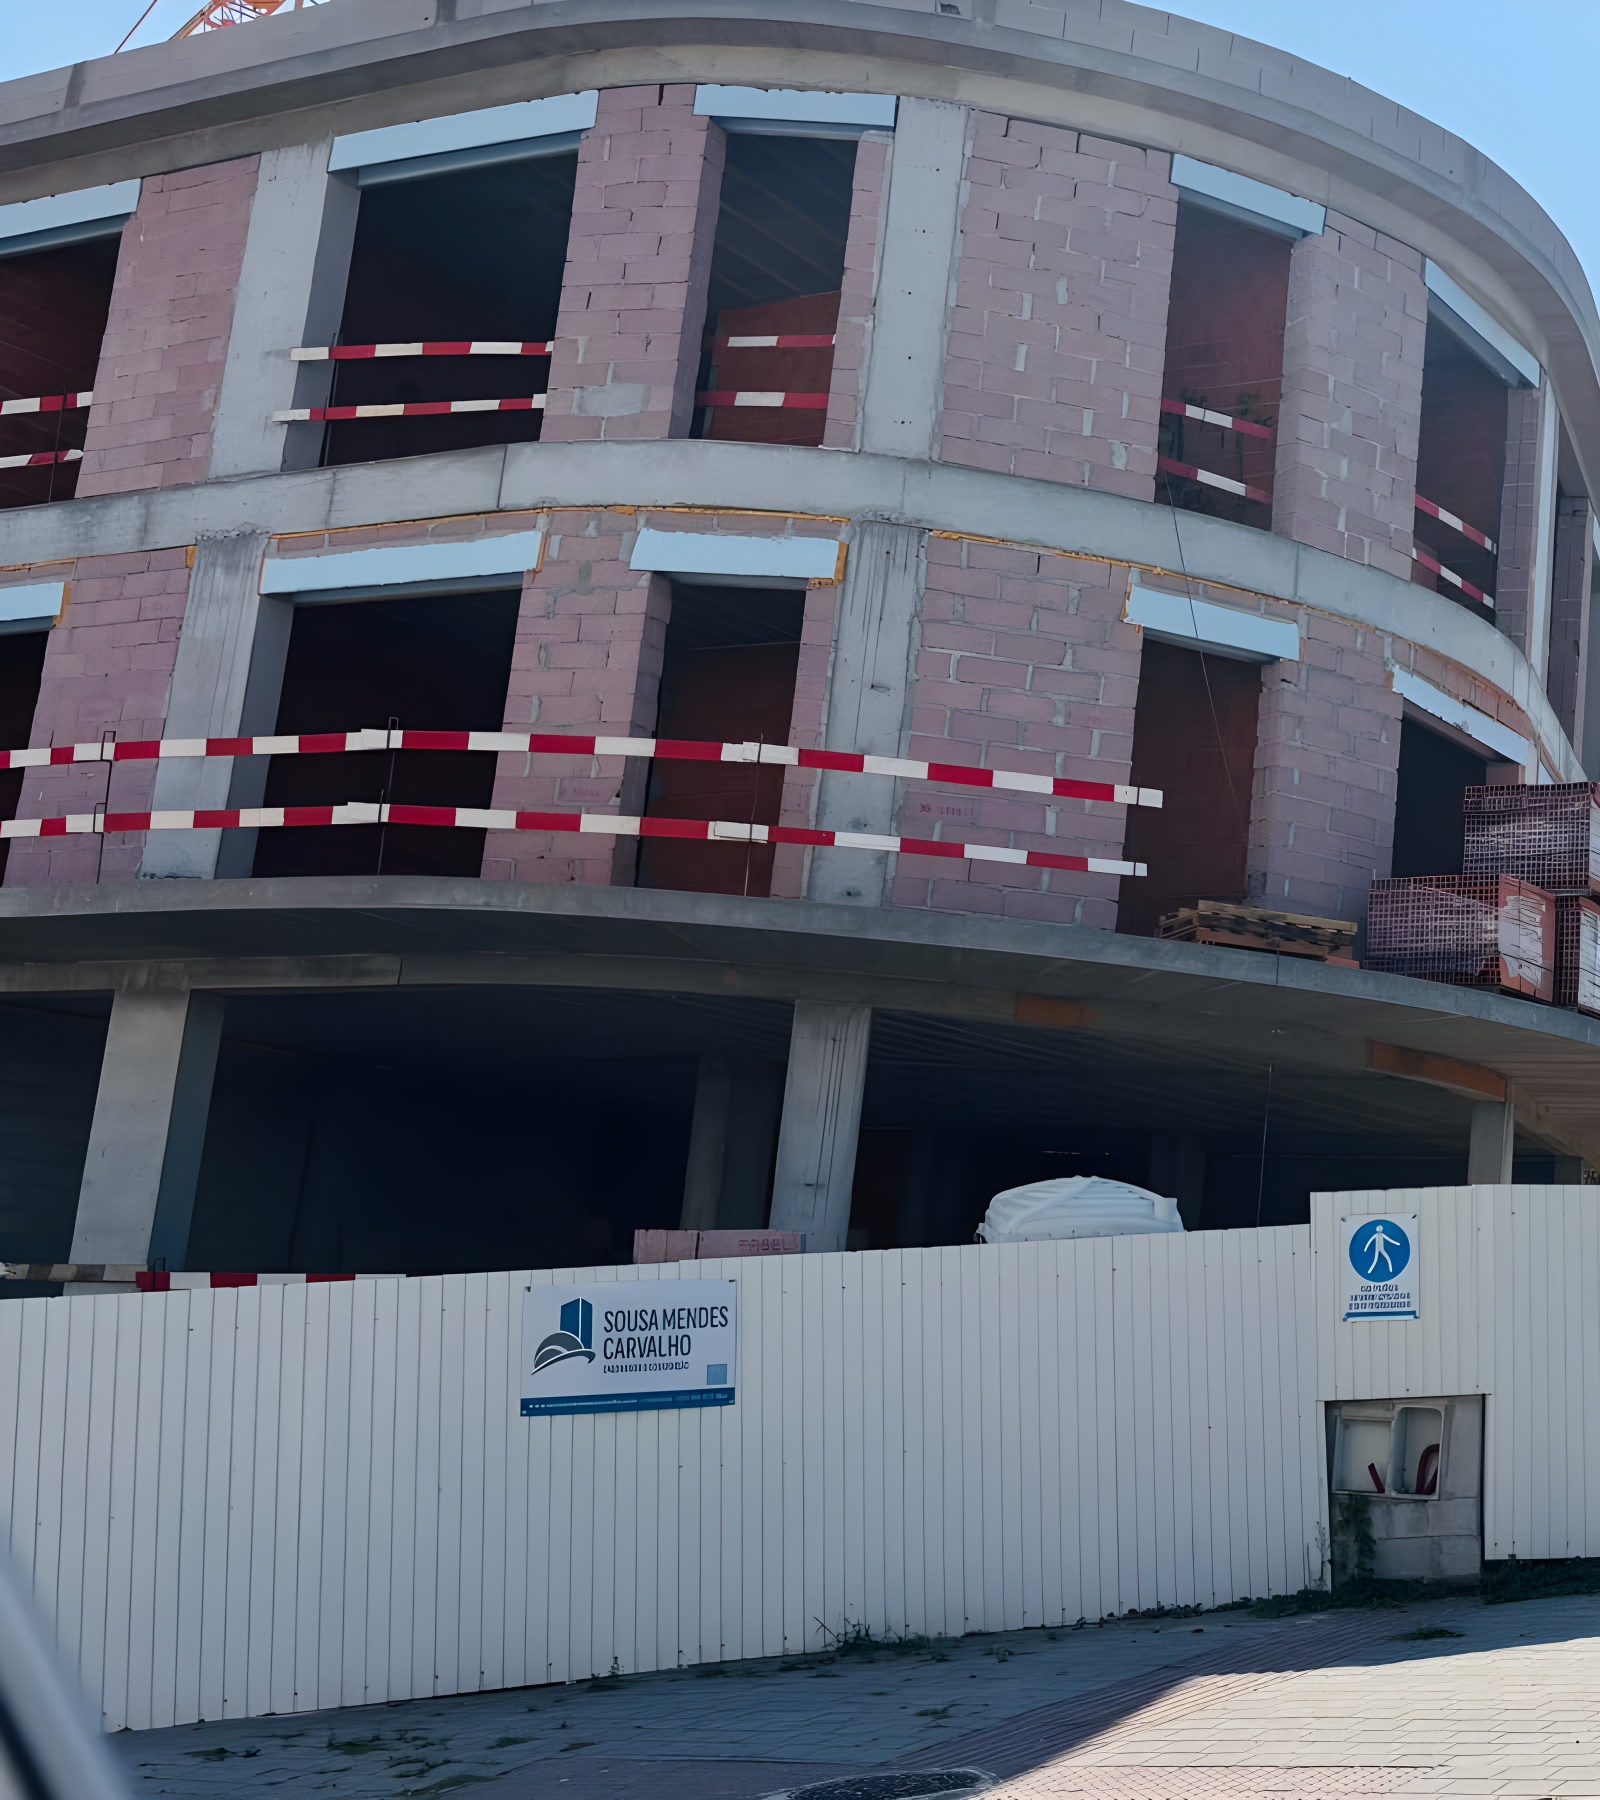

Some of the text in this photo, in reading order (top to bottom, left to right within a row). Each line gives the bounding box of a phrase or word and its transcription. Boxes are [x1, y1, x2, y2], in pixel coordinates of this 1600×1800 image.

[603, 1306, 729, 1333] SOUSA MENDES
[603, 1334, 692, 1360] CARVALHO
